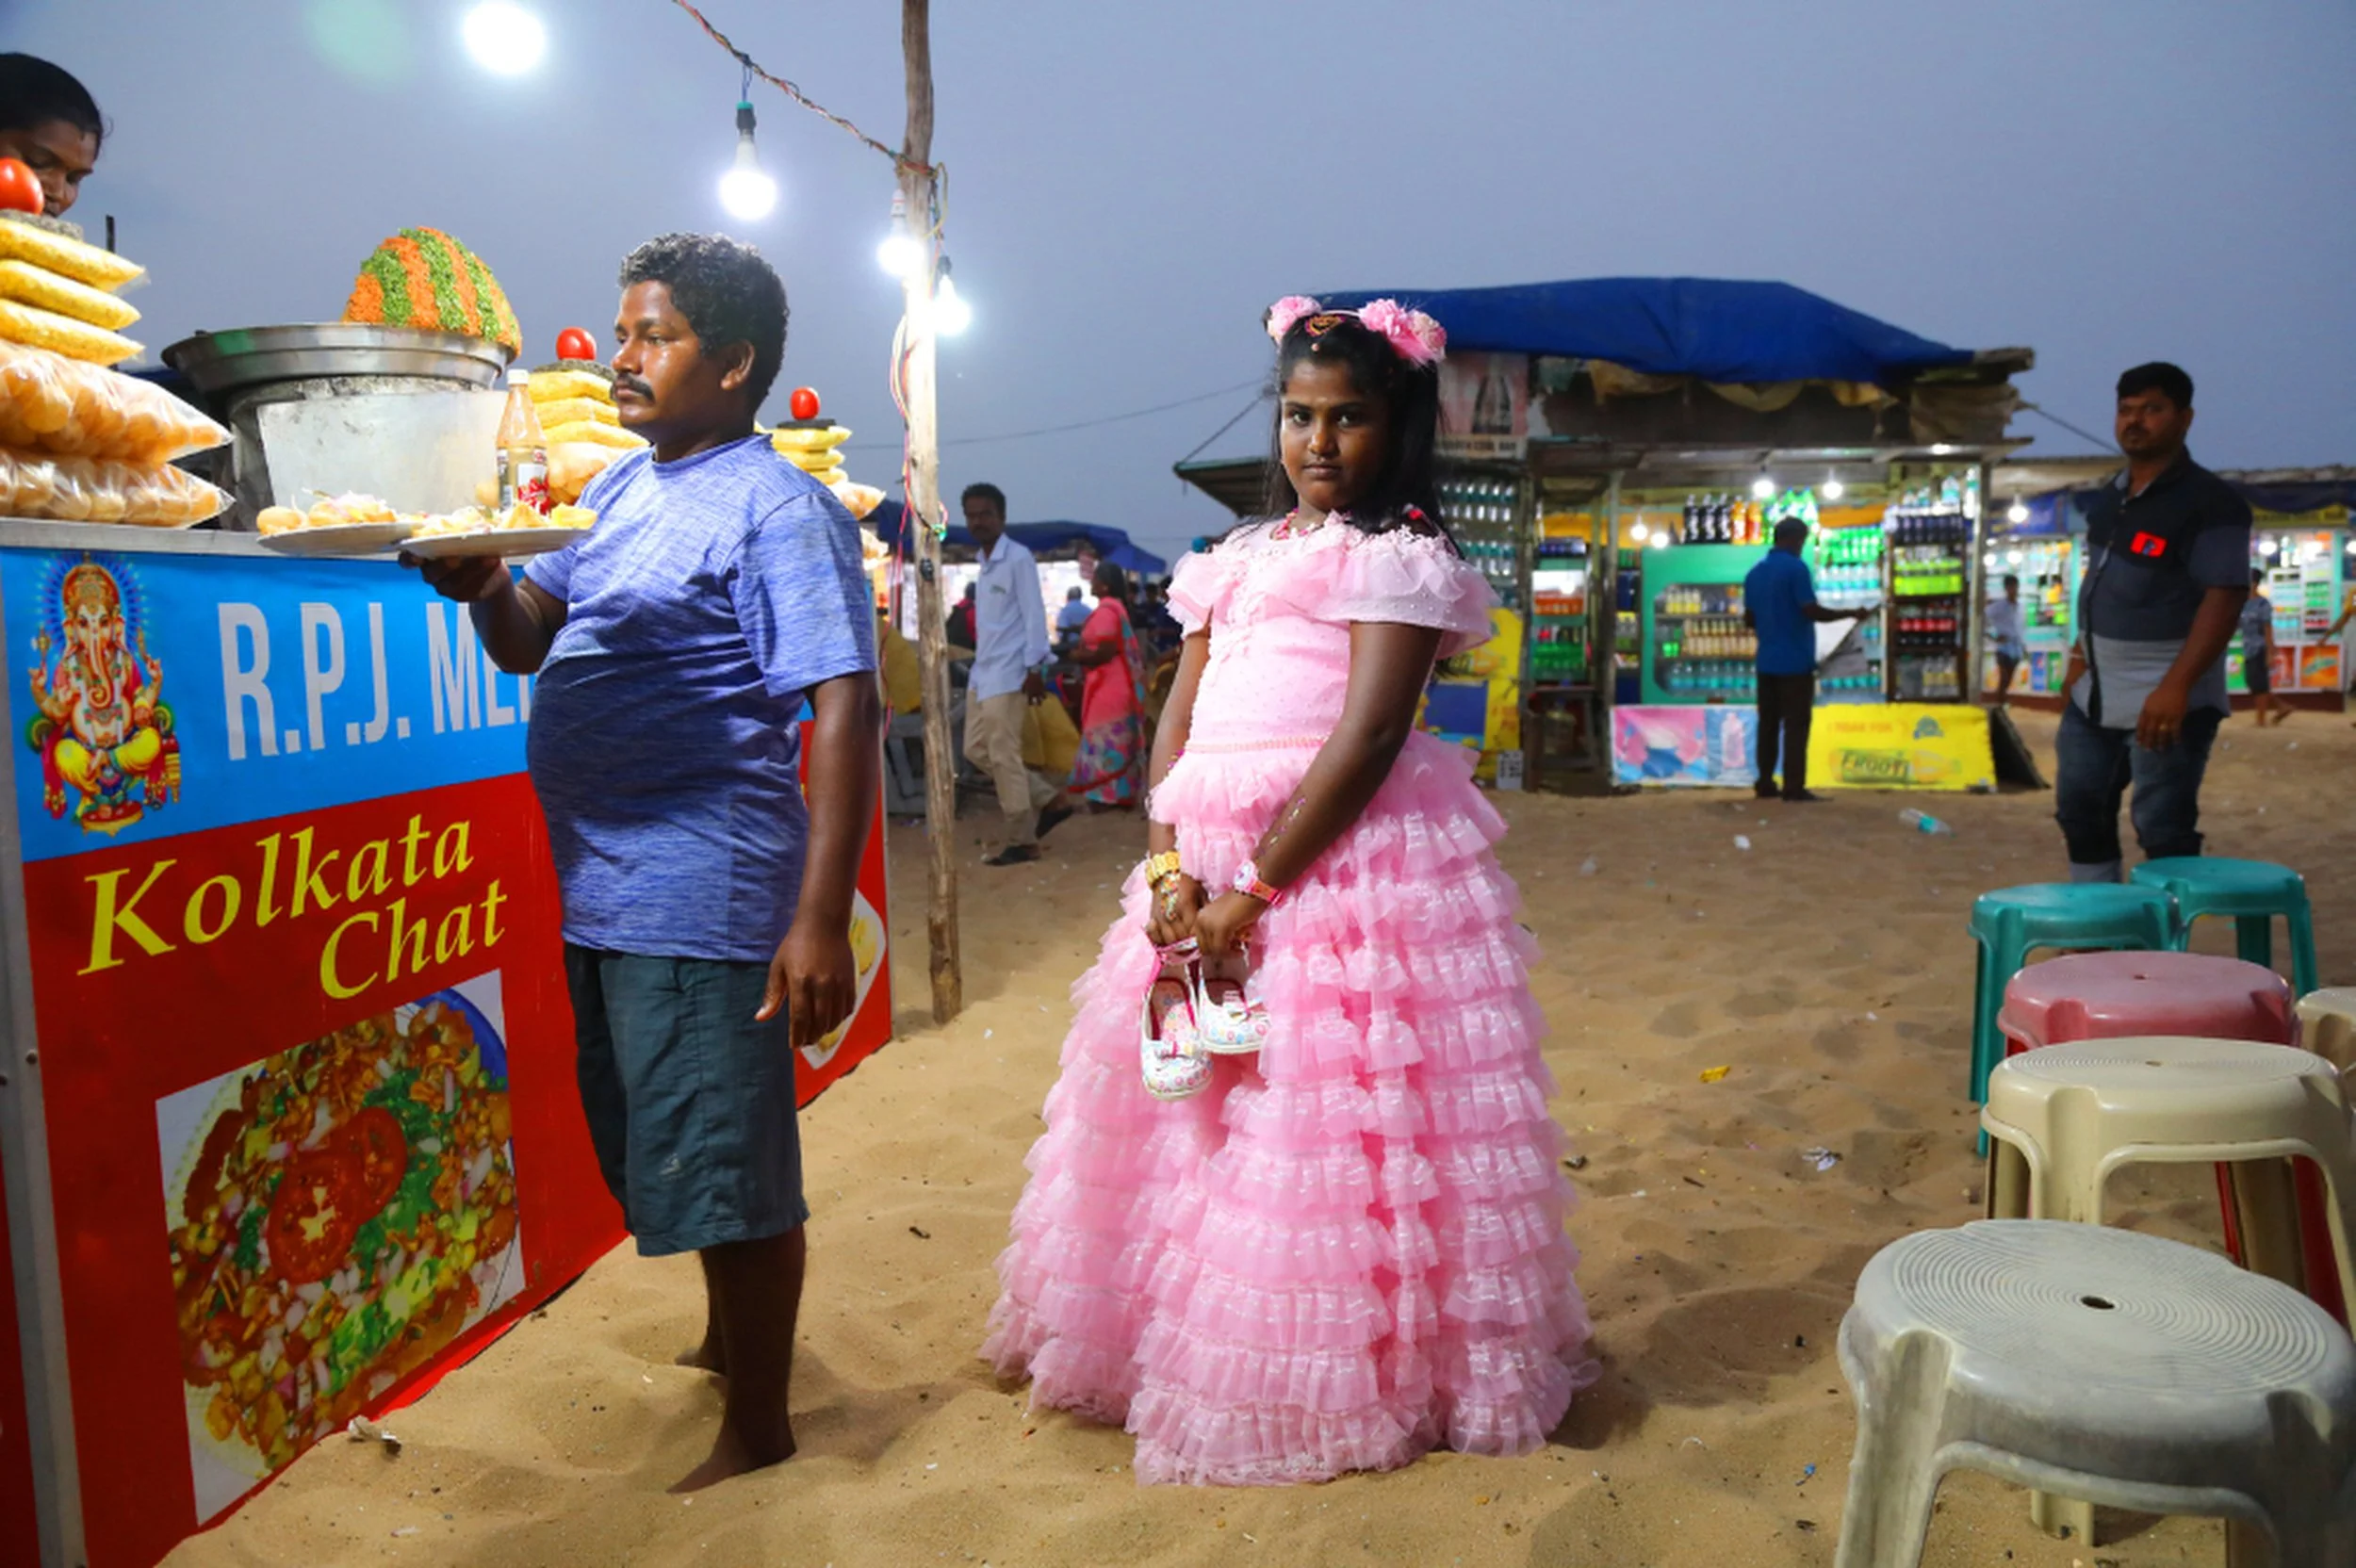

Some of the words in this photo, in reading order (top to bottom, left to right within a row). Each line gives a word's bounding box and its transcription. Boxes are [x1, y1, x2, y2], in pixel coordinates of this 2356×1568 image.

[218, 602, 411, 760] R.P.J.
[76, 814, 473, 975] Kolkata
[319, 879, 508, 1000] Chat
